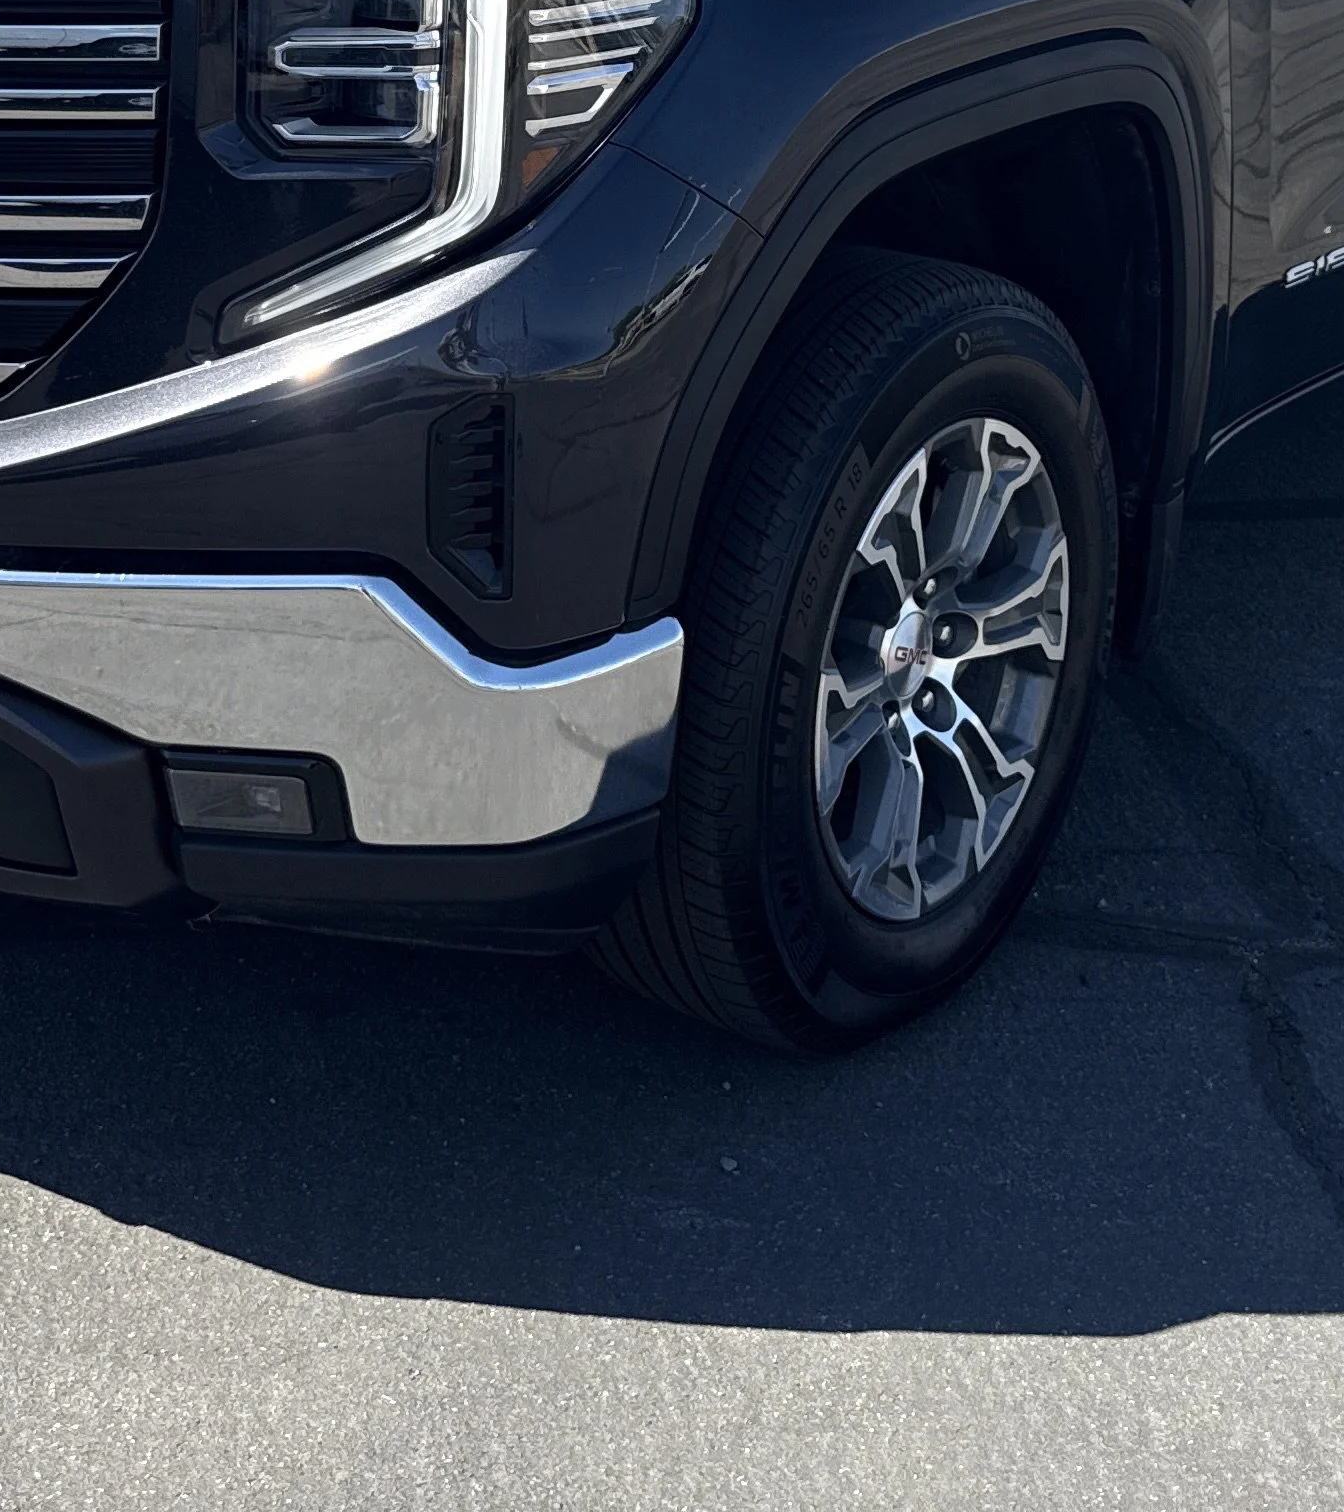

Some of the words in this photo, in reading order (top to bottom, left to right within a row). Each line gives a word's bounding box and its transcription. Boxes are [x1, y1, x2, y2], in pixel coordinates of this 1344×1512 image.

[797, 523, 836, 627] 265/65
[834, 496, 847, 520] R
[846, 462, 862, 491] 18
[895, 646, 928, 665] GMC
